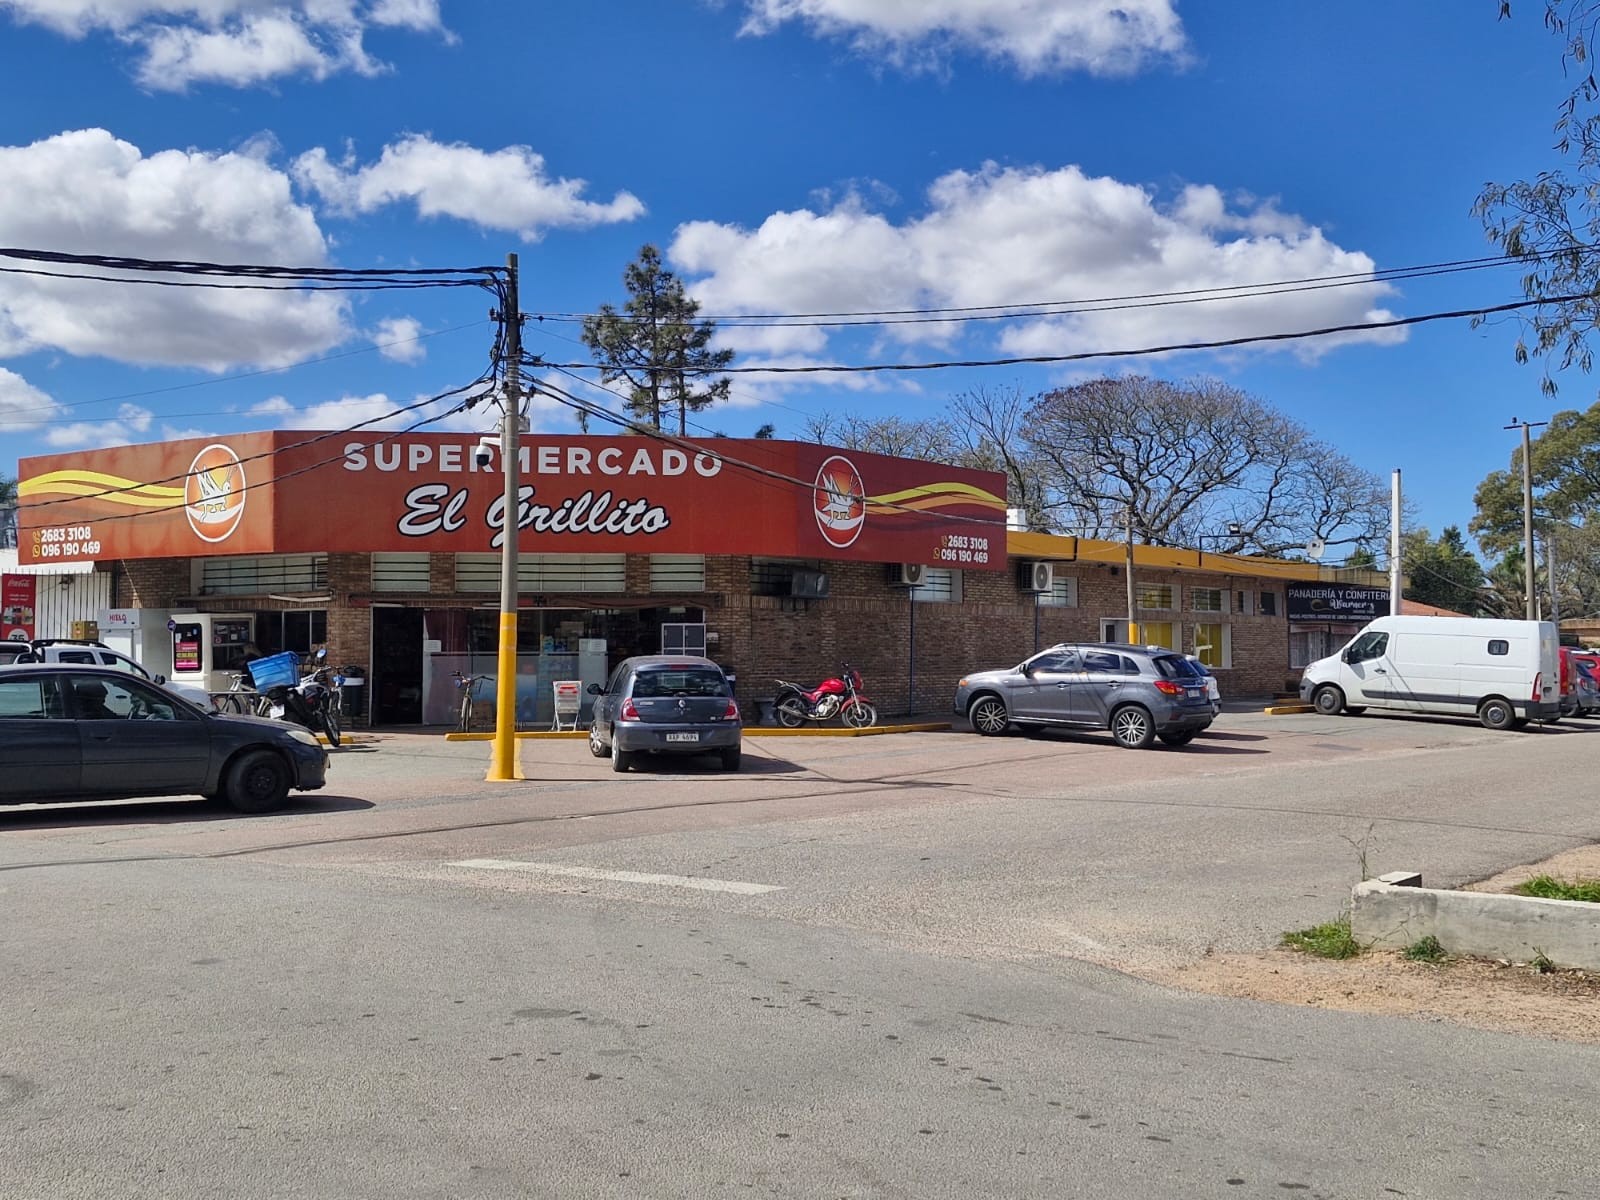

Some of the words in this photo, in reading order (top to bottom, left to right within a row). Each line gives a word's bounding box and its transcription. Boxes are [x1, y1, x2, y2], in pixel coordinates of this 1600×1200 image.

[343, 442, 722, 477] SUPERMERCADO
[397, 483, 469, 537] El
[485, 485, 671, 548] Grillito
[41, 528, 66, 543] 2683
[67, 526, 91, 541] 3108
[948, 535, 968, 549] 2683
[970, 537, 988, 550] 3108
[41, 543, 60, 557] 096
[62, 542, 79, 556] 190
[81, 541, 101, 555] 469
[941, 548, 957, 561] 096
[958, 550, 972, 562] 190
[973, 551, 988, 563] 469
[1288, 588, 1336, 599] PANADERÍA
[1337, 590, 1343, 599] Y
